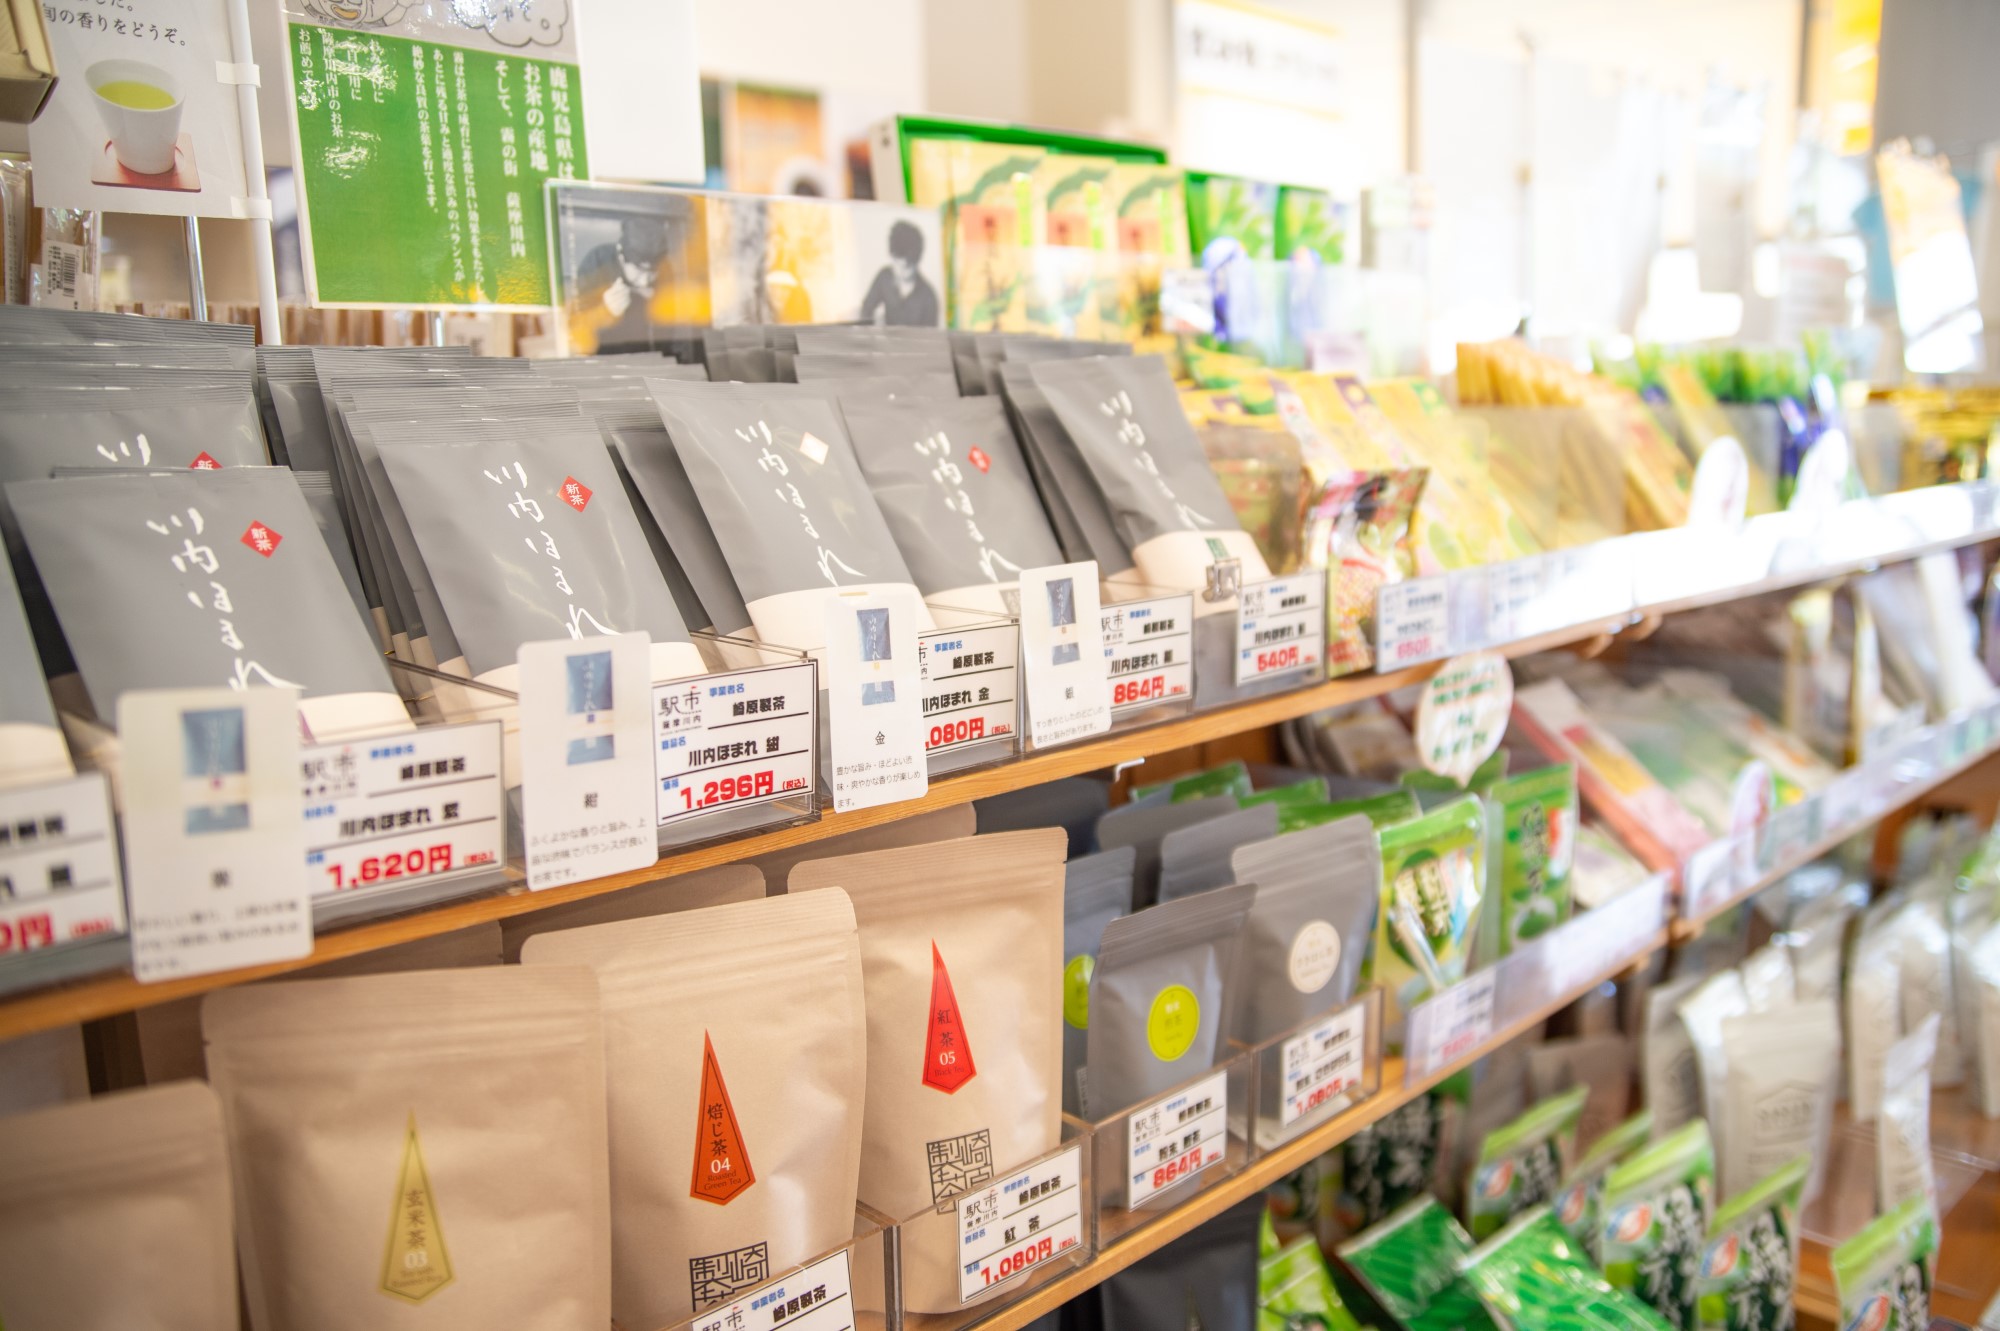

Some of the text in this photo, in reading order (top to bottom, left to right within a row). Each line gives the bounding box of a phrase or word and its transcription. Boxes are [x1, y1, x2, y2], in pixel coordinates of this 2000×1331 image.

[523, 62, 549, 172] お茶の産地
[566, 483, 584, 506] 新茶
[251, 527, 273, 552] 新茶
[1111, 653, 1158, 674] 川内ほまれ
[658, 688, 702, 716] 駅市
[978, 687, 990, 702] 金
[1114, 675, 1164, 704] 864円
[733, 696, 785, 717] 崎原製茶
[875, 731, 885, 745] 金
[924, 717, 984, 750] ,080円
[688, 740, 758, 768] 川内ほまれ
[680, 770, 774, 810] 1,296円
[837, 798, 855, 808] ます。
[327, 843, 453, 889] 1,620円
[937, 1008, 954, 1048] 紅茶
[940, 1051, 956, 1066] 05
[707, 1103, 727, 1157] 焙じ茶
[708, 1170, 737, 1182] Roasted
[711, 1157, 731, 1174] 04
[1153, 1146, 1202, 1189] 864円
[704, 1177, 742, 1191] Green Tea
[980, 1236, 1053, 1286] 1,080円
[772, 1284, 827, 1323] 崎原製茶
